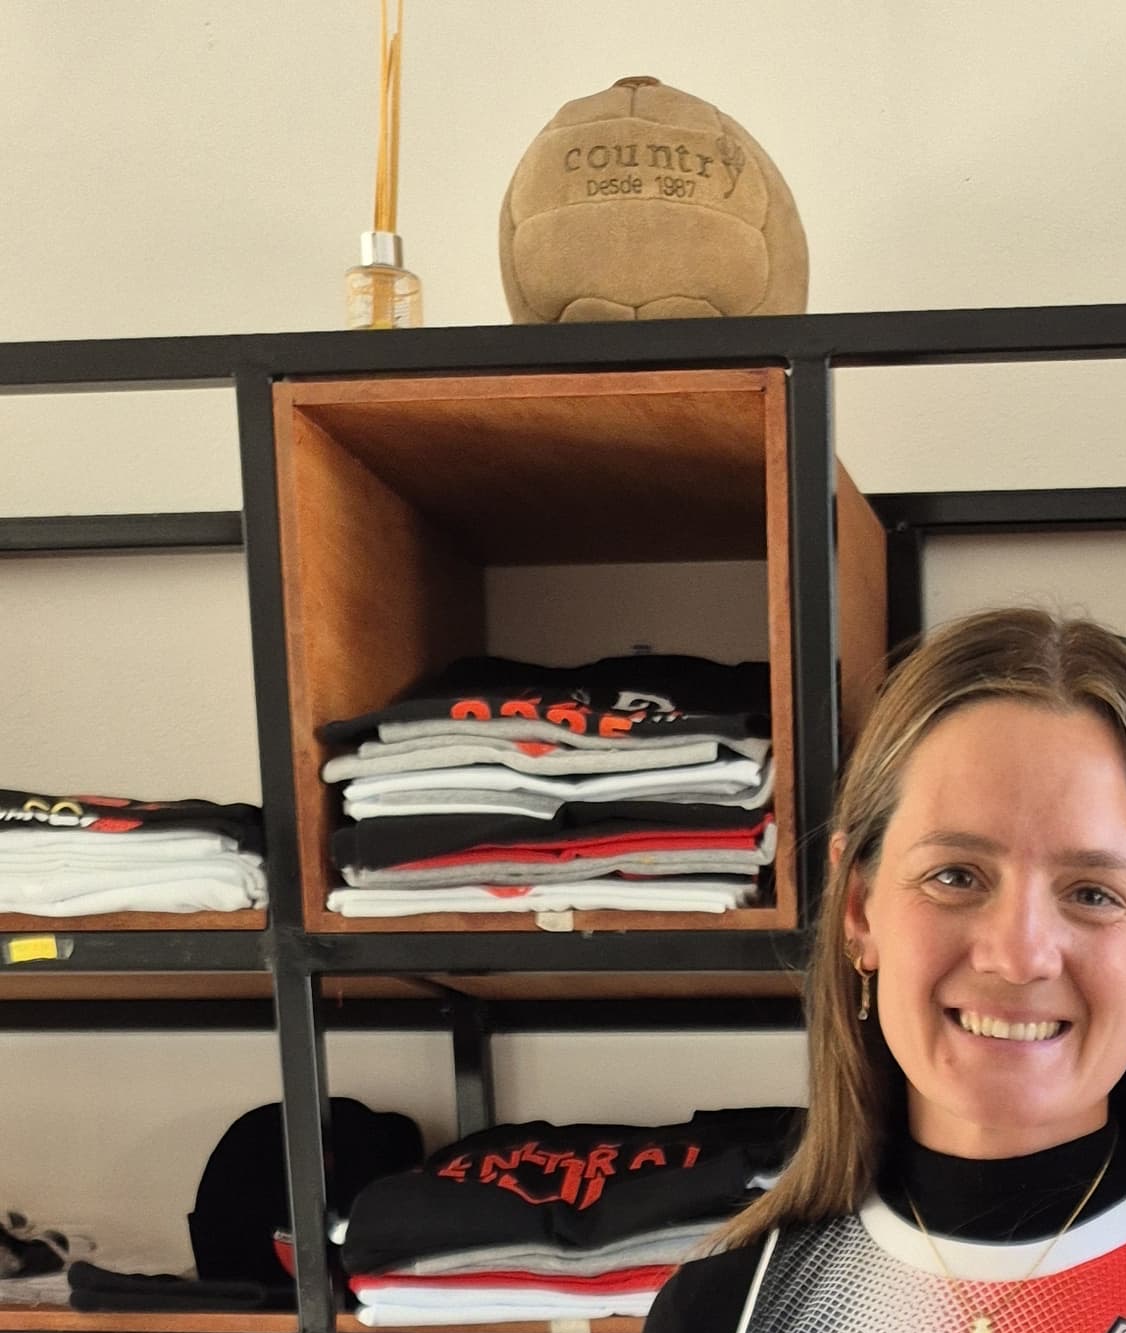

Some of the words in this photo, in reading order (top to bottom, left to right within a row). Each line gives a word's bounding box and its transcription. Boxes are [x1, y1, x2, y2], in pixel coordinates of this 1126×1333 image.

[564, 133, 746, 200] country
[587, 175, 643, 197] Desde
[654, 176, 696, 198] 1987
